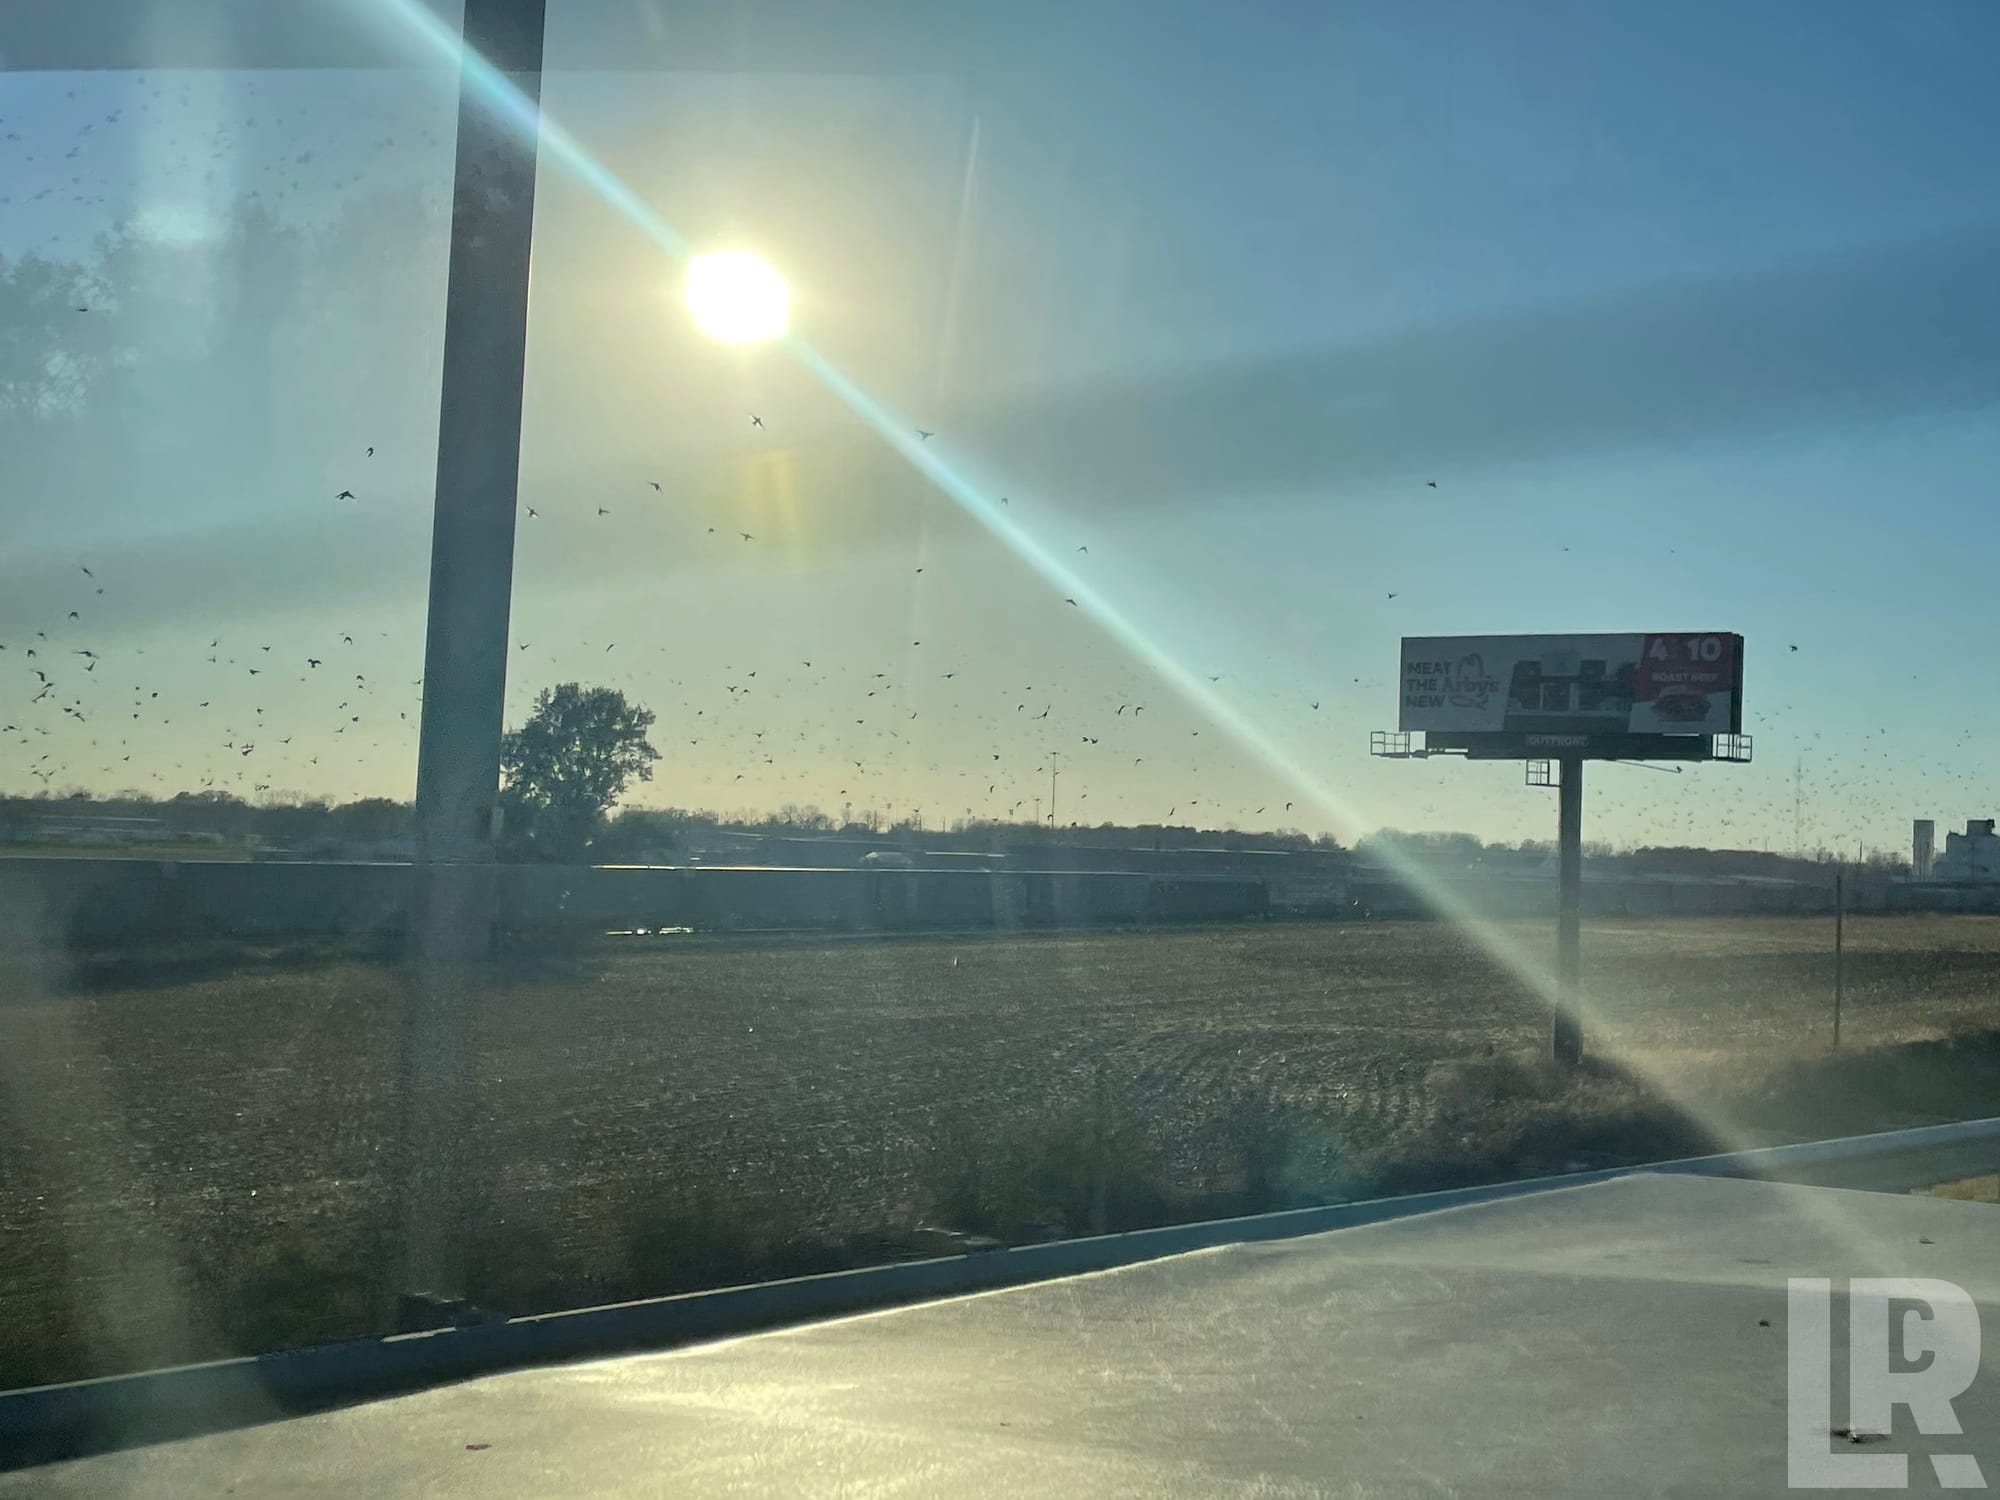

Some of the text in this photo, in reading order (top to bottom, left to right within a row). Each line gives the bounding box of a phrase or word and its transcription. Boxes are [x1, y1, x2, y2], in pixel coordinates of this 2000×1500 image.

[1687, 636, 1722, 662] 10
[1406, 661, 1453, 675] MEAT
[1406, 678, 1438, 692] THE
[1406, 695, 1446, 708] NEW
[1527, 735, 1588, 746] OUTFRONT
